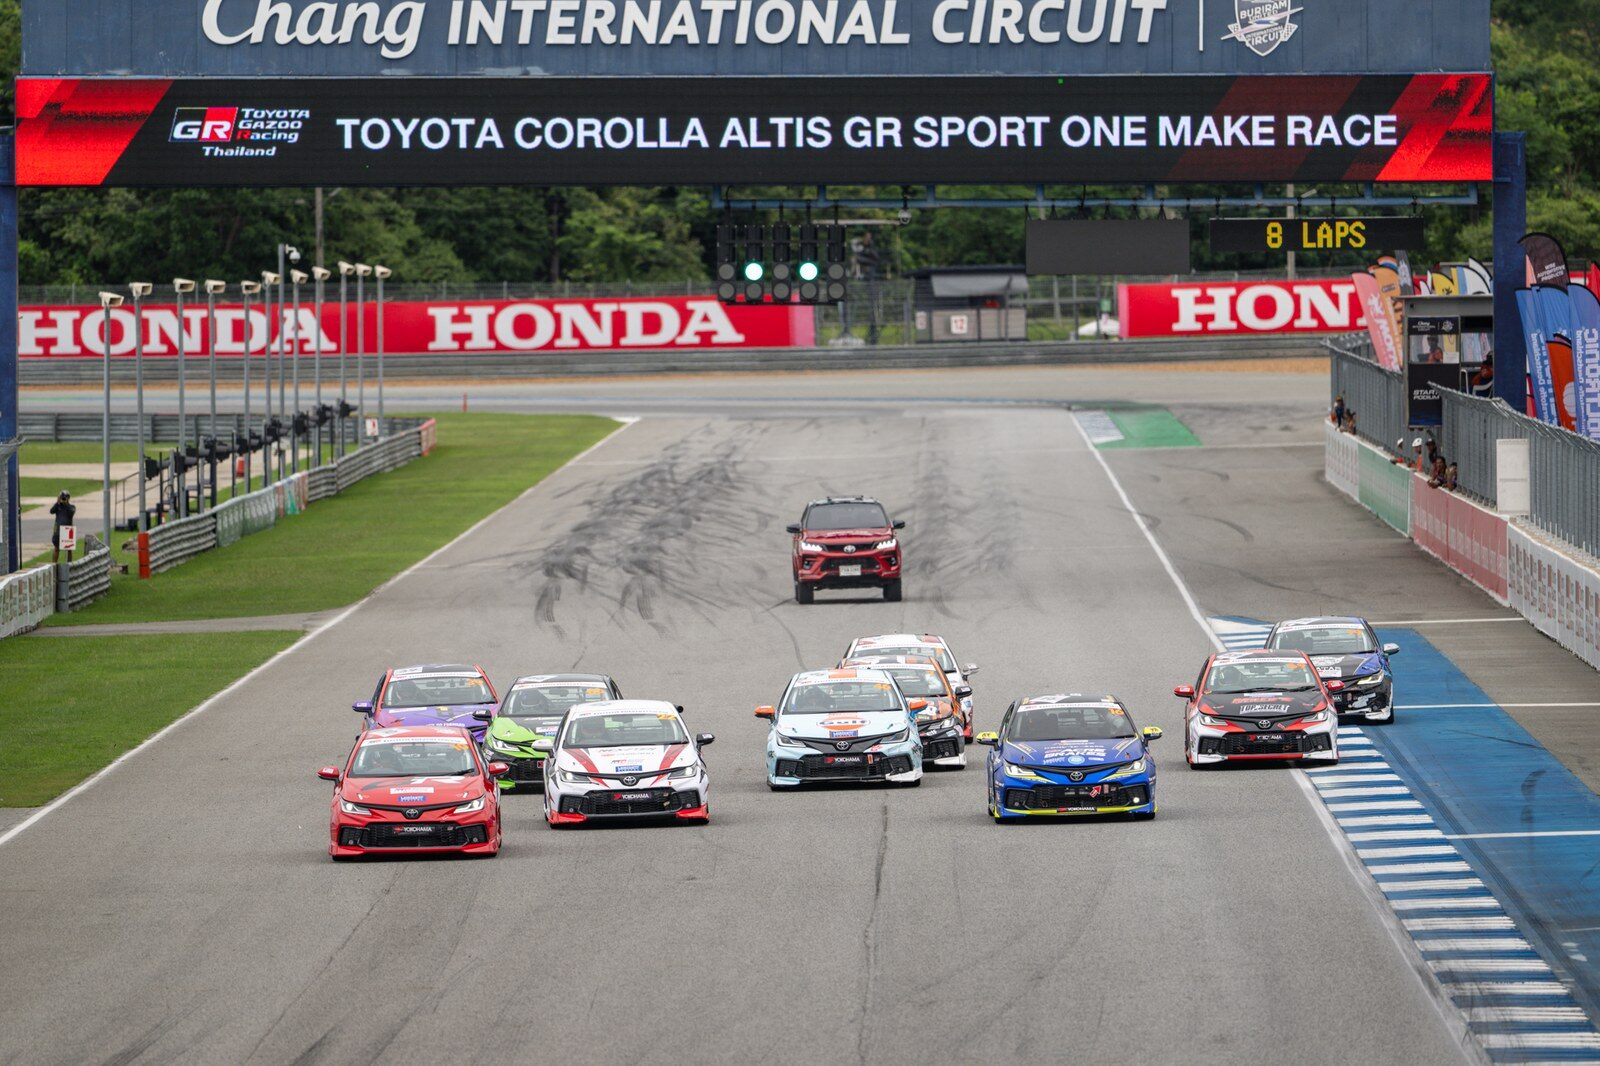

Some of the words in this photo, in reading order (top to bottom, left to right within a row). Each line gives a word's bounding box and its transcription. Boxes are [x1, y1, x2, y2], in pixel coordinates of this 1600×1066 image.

[1240, 1, 1287, 19] BURIRAM
[202, 0, 426, 59] Chang
[447, 0, 910, 45] INTERNATIONAL
[932, 0, 1166, 44] CIRCUIT
[238, 119, 303, 130] GAZOO
[241, 108, 310, 119] TOYOTA
[173, 120, 231, 139] GR
[236, 129, 299, 143] Racing
[336, 118, 504, 150] TOYOTA
[514, 117, 710, 149] COROLLA
[719, 116, 833, 148] ALTIS
[843, 116, 903, 148] GR
[913, 115, 1051, 148] SPORT
[1060, 115, 1147, 148] ONE
[1158, 115, 1275, 148] MAKE
[1287, 114, 1397, 147] RACE
[202, 146, 277, 157] Thailand
[1266, 222, 1283, 249] 8
[1302, 222, 1366, 249] LAPS
[1171, 284, 1369, 331] HON
[19, 308, 337, 354] HONDA
[428, 299, 745, 350] HONDA
